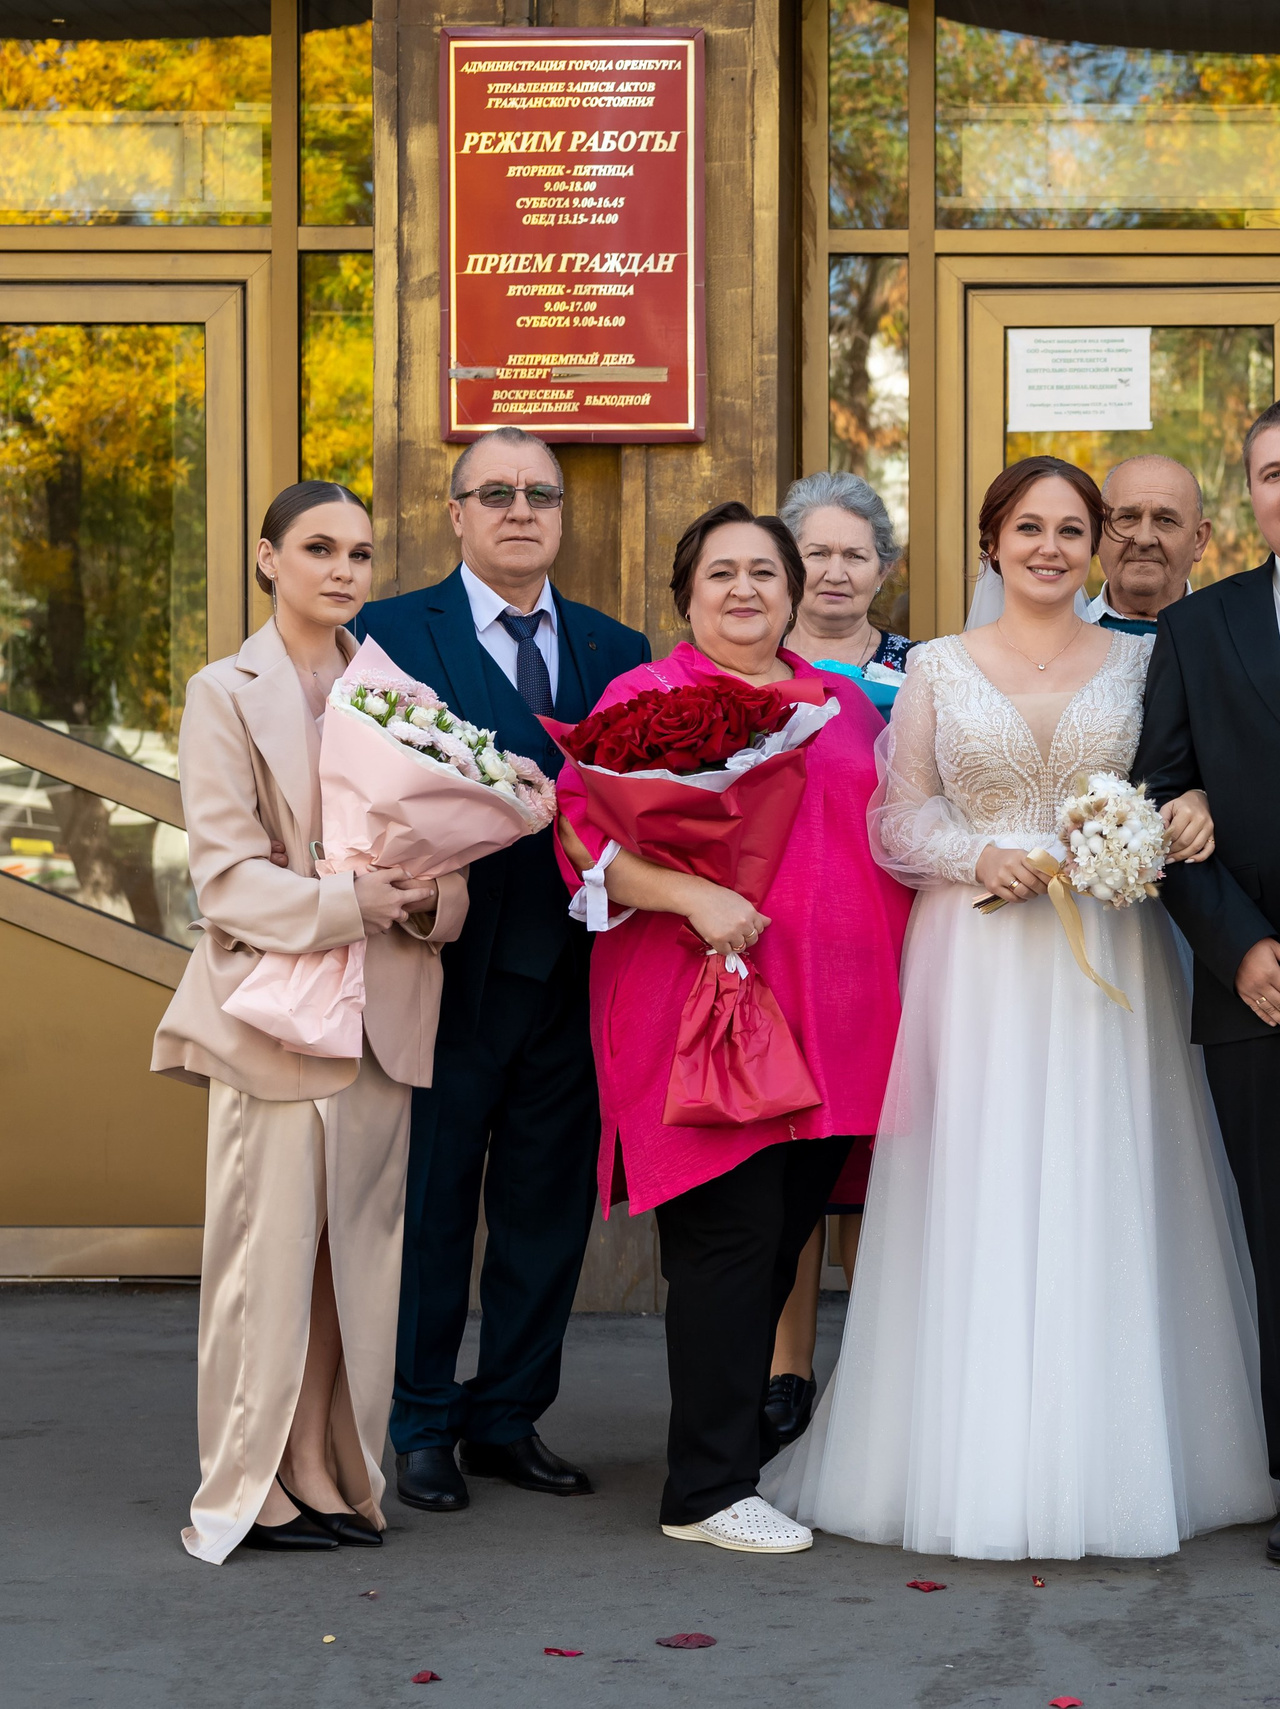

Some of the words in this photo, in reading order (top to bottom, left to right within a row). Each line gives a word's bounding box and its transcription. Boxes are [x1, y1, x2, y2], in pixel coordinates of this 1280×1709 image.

[460, 60, 567, 73] АДМИНИСТРАЦИЯ
[567, 60, 613, 72] ГОРОДА
[614, 60, 682, 71] ОРЕНБУРГА
[486, 82, 565, 94] УПРАВЛЕНИЕ
[566, 82, 614, 93] ЗАПИСИ
[615, 82, 656, 93] АКТОВ
[485, 97, 580, 109] ГРАЖДАНСКОГО
[582, 96, 655, 108] СОСТОЯНИЯ
[460, 131, 566, 154] РЕЖИМ
[567, 130, 682, 152] РАБОТЫ
[505, 165, 565, 177] ВТОРНИК
[572, 164, 635, 177] ПЯТНИЦА
[544, 181, 597, 192] 9.00-18.00
[515, 198, 570, 209] СУББОТА
[572, 197, 626, 208] 9.00-16.45
[522, 213, 555, 226] ОБЕД
[590, 213, 619, 224] 14.00
[463, 253, 556, 274] ПРИЕМ
[557, 253, 678, 277] ГРАЖДАН
[505, 285, 565, 297] ВТОРНИК
[572, 284, 635, 297] ПЯТНИЦА
[544, 301, 597, 312] 9.00-17.00
[516, 316, 570, 328] СУББОТА
[572, 316, 626, 327] 9.00-16.00
[506, 352, 600, 366] НЕПРИЕМНЫЙ
[601, 353, 636, 366] ДЕНЬ
[496, 368, 550, 379] ЧЕТВЕРГ
[492, 389, 575, 400] ВОСКРЕСЕНЬЕ
[584, 393, 651, 407] ВЫХОДНОЙ
[492, 402, 580, 414] ПОНЕДЕЛЬНИК
